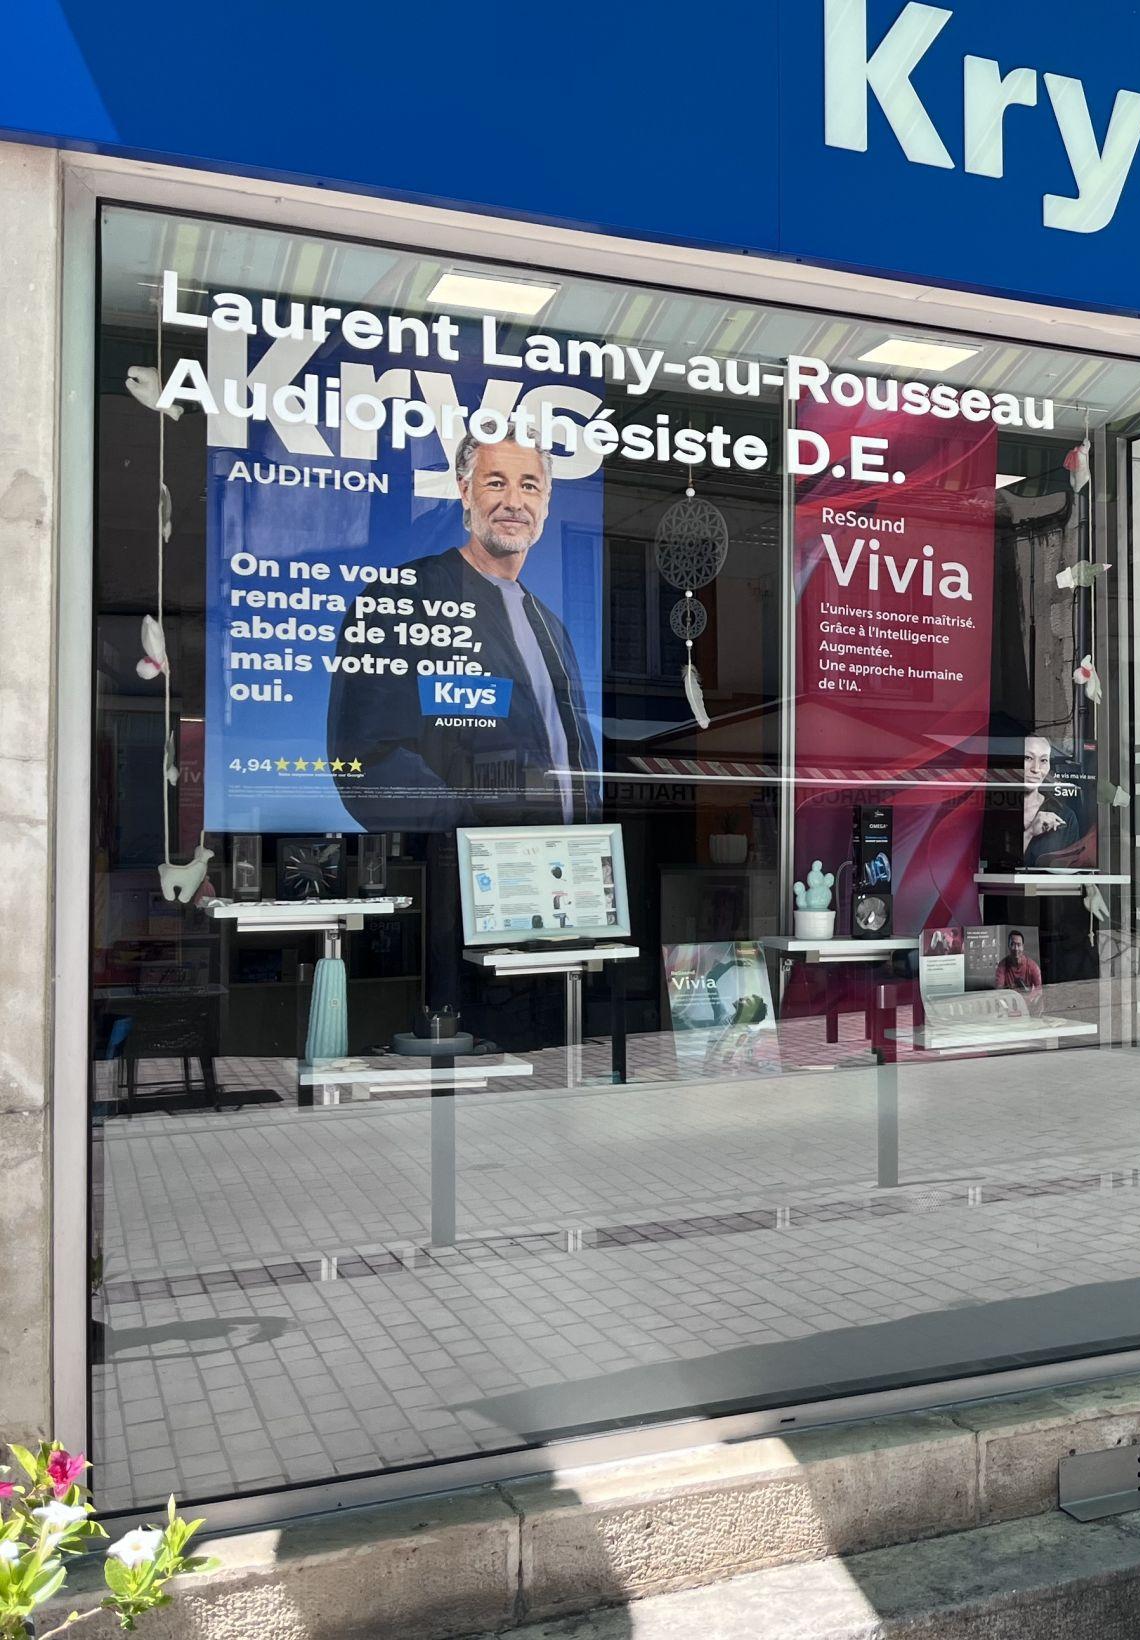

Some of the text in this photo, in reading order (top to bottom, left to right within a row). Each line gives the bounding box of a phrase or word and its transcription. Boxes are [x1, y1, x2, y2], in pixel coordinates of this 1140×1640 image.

[162, 270, 1055, 431] Laurent Lamy-au-Rousseau
[155, 356, 907, 484] Audioprothésiste D.E.
[206, 316, 605, 500] Krys
[227, 461, 389, 494] AUDITION
[822, 507, 905, 535] ReSound
[230, 552, 417, 586] On ne vous
[821, 533, 973, 601] Vivia
[230, 587, 477, 619] rendra pas vos
[819, 620, 857, 638] Grâce
[858, 623, 866, 638] à
[876, 609, 920, 624] sonore
[922, 610, 976, 629] maîtrisé.
[230, 615, 483, 653] abdos de 1982,
[230, 648, 313, 673] mais
[321, 653, 409, 676] votre
[819, 640, 893, 659] Augmentée.
[818, 677, 836, 690] de
[819, 659, 964, 682] Une approche humaine
[230, 679, 294, 702] oui.
[434, 682, 497, 709] Krys
[435, 717, 497, 728] AUDITION
[229, 758, 273, 774] 4,94
[1054, 786, 1078, 797] Savi
[671, 975, 717, 991] Vivia
